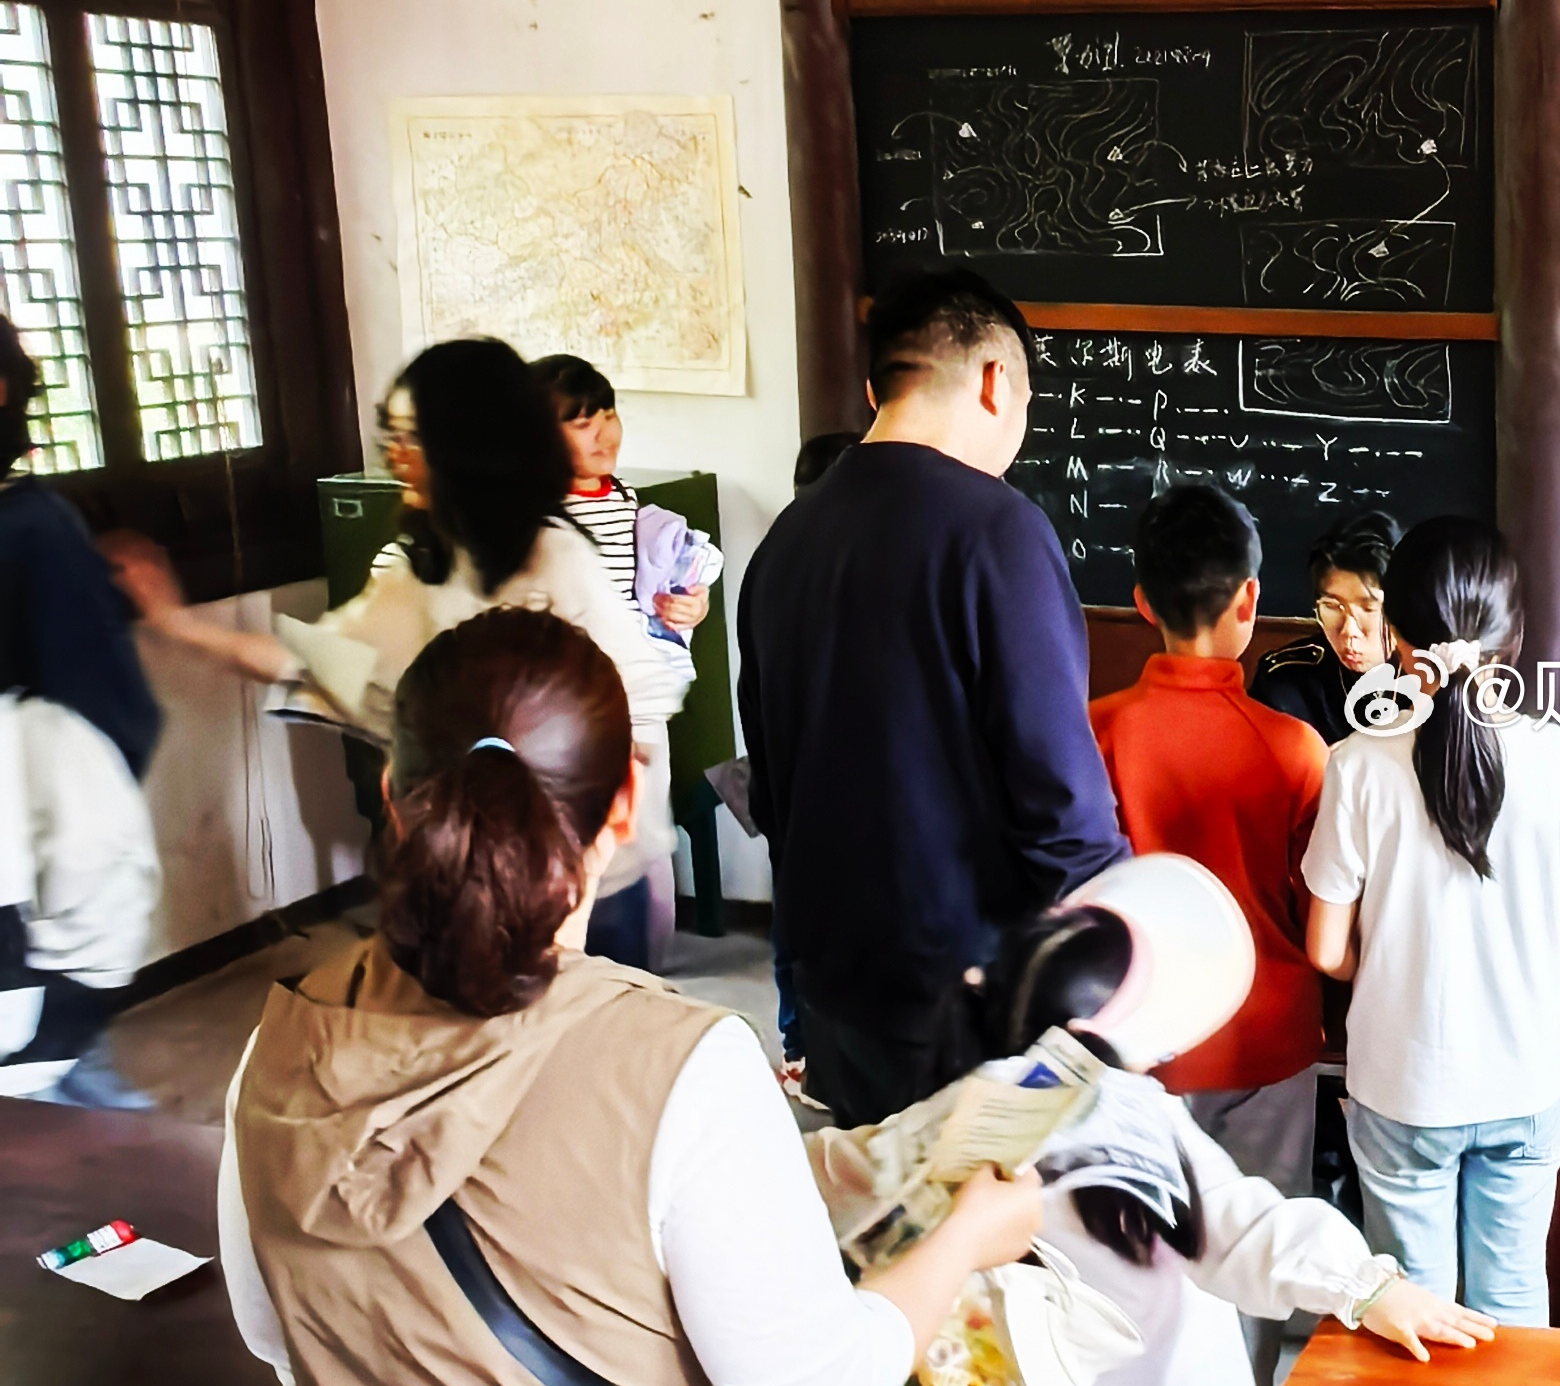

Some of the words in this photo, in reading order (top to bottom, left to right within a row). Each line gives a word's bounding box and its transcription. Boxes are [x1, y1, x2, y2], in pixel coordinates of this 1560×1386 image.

[1069, 382, 1086, 409] K
[1153, 389, 1168, 421] P
[1070, 417, 1086, 439] L
[1150, 426, 1166, 452] Q
[1315, 432, 1339, 462] Y
[1066, 455, 1089, 482] M
[1317, 481, 1342, 503] Z
[1069, 489, 1089, 519] N
